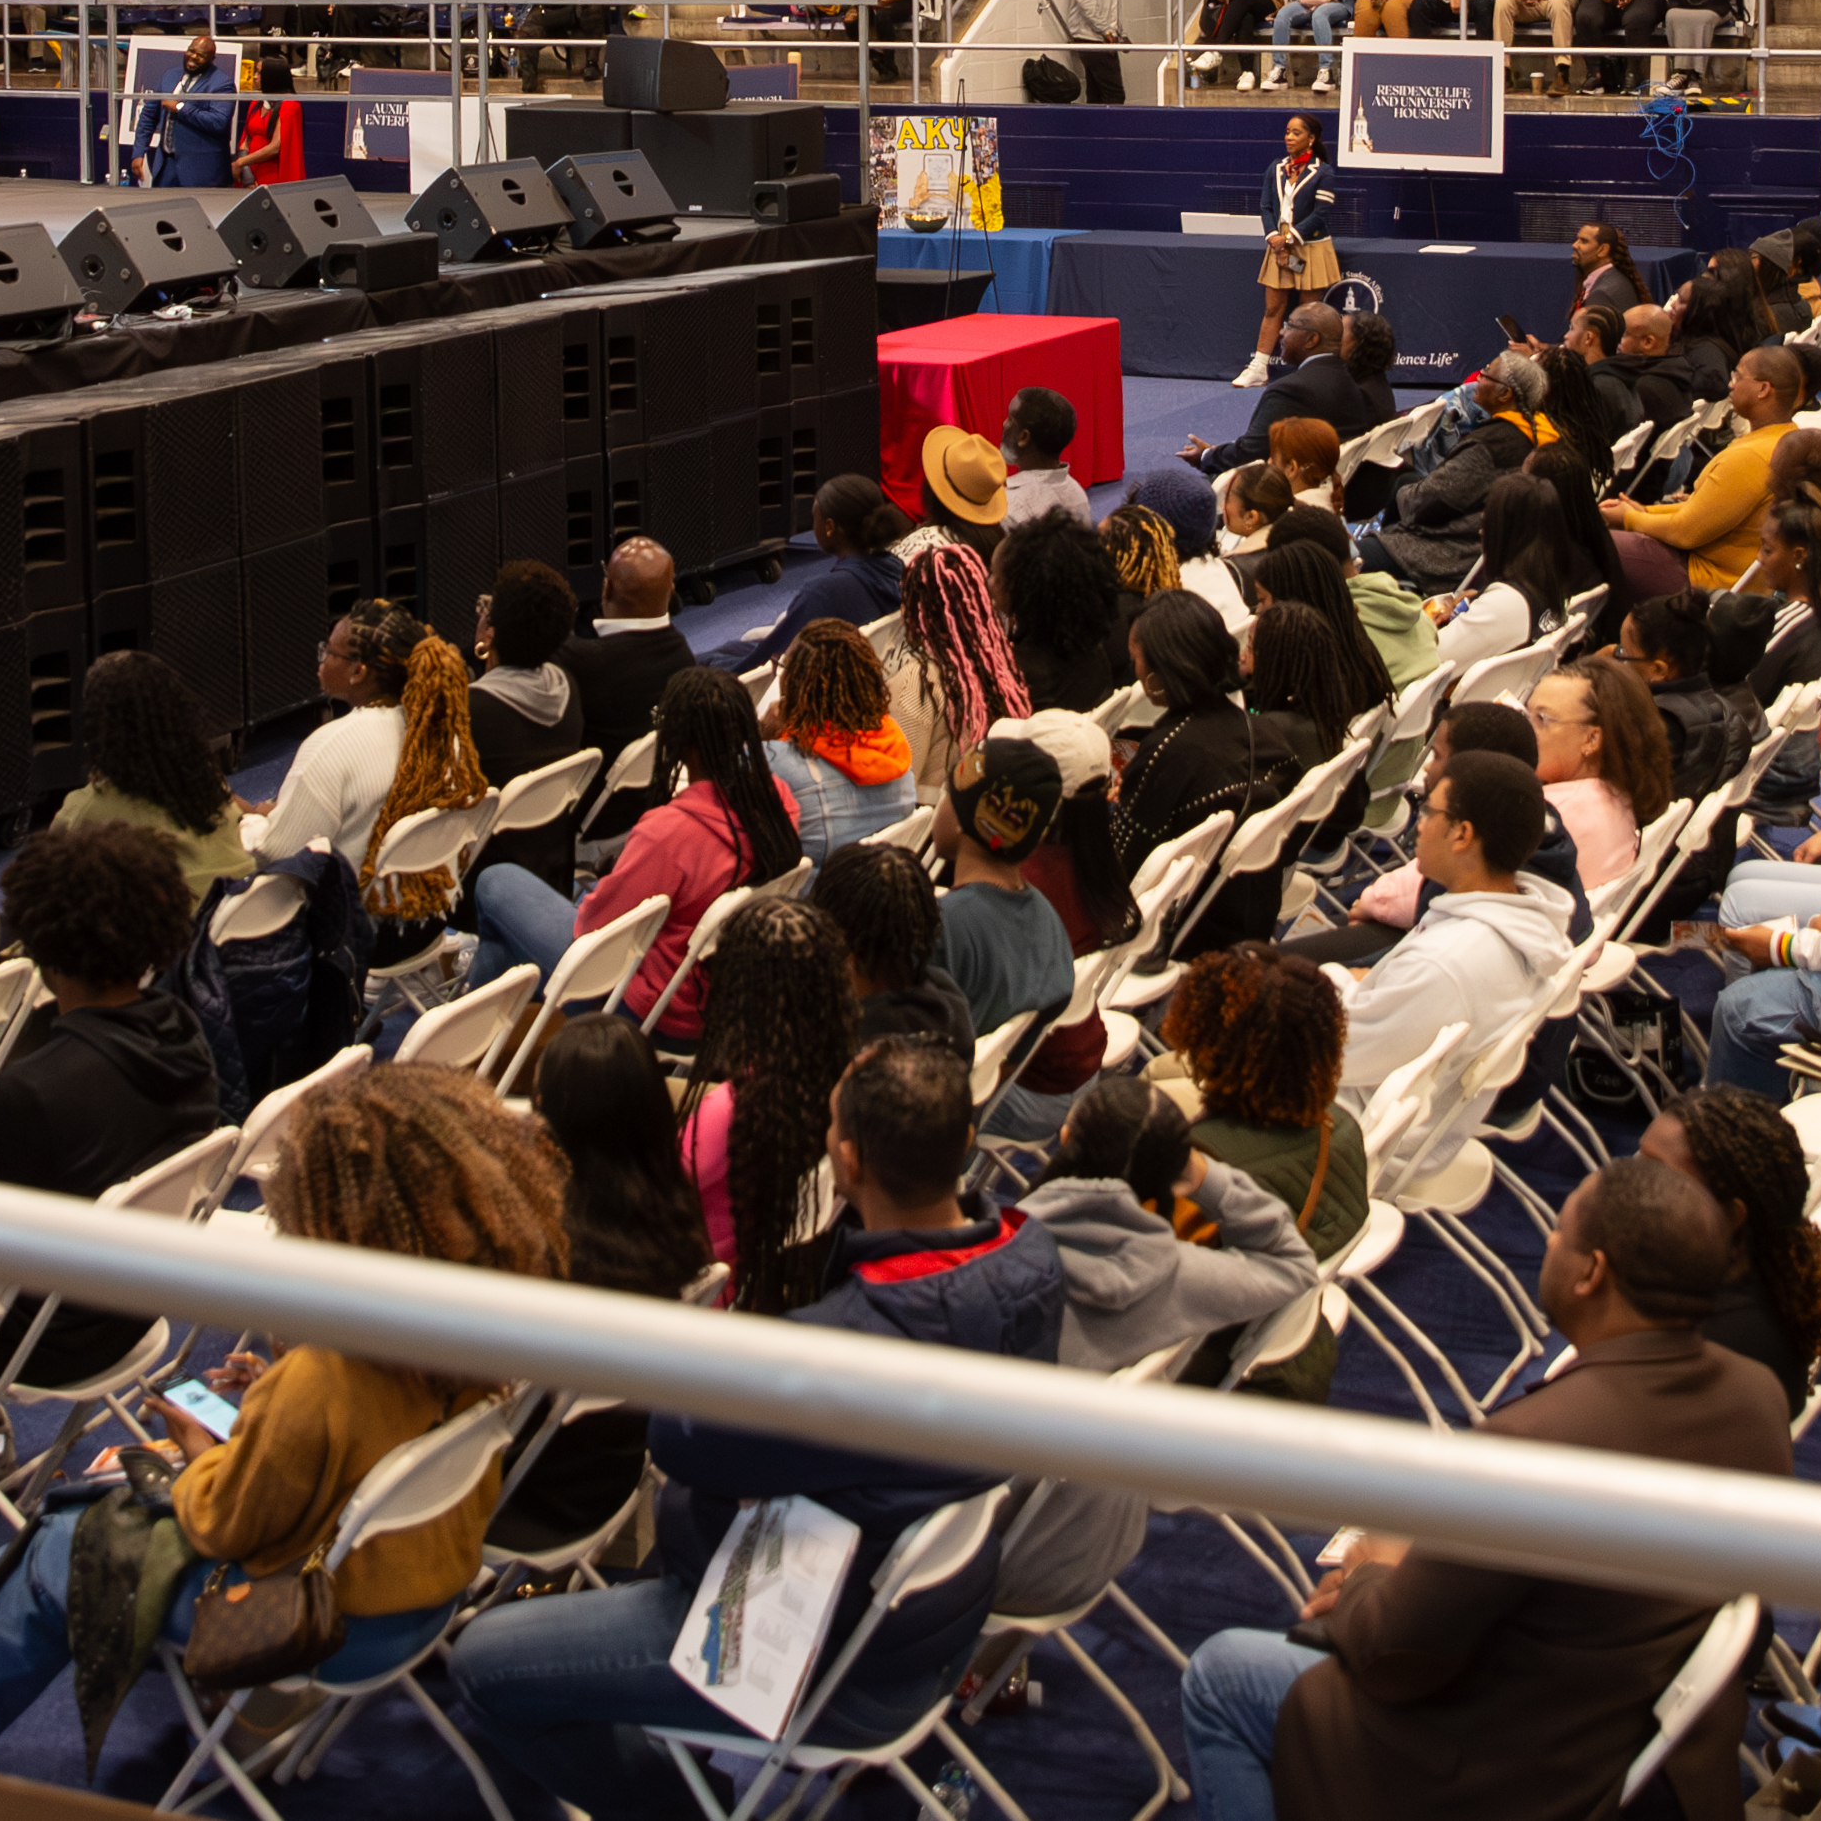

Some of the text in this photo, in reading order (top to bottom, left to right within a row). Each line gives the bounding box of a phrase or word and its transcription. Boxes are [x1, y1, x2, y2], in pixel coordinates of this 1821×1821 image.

[1375, 83, 1472, 100] RESIDENCE LIFE
[372, 103, 410, 116] AUXILI
[1371, 95, 1473, 113] AND UNIVERSITY
[365, 113, 410, 127] ENTERP
[1393, 106, 1451, 122] HOUSING
[1396, 352, 1427, 366] dence
